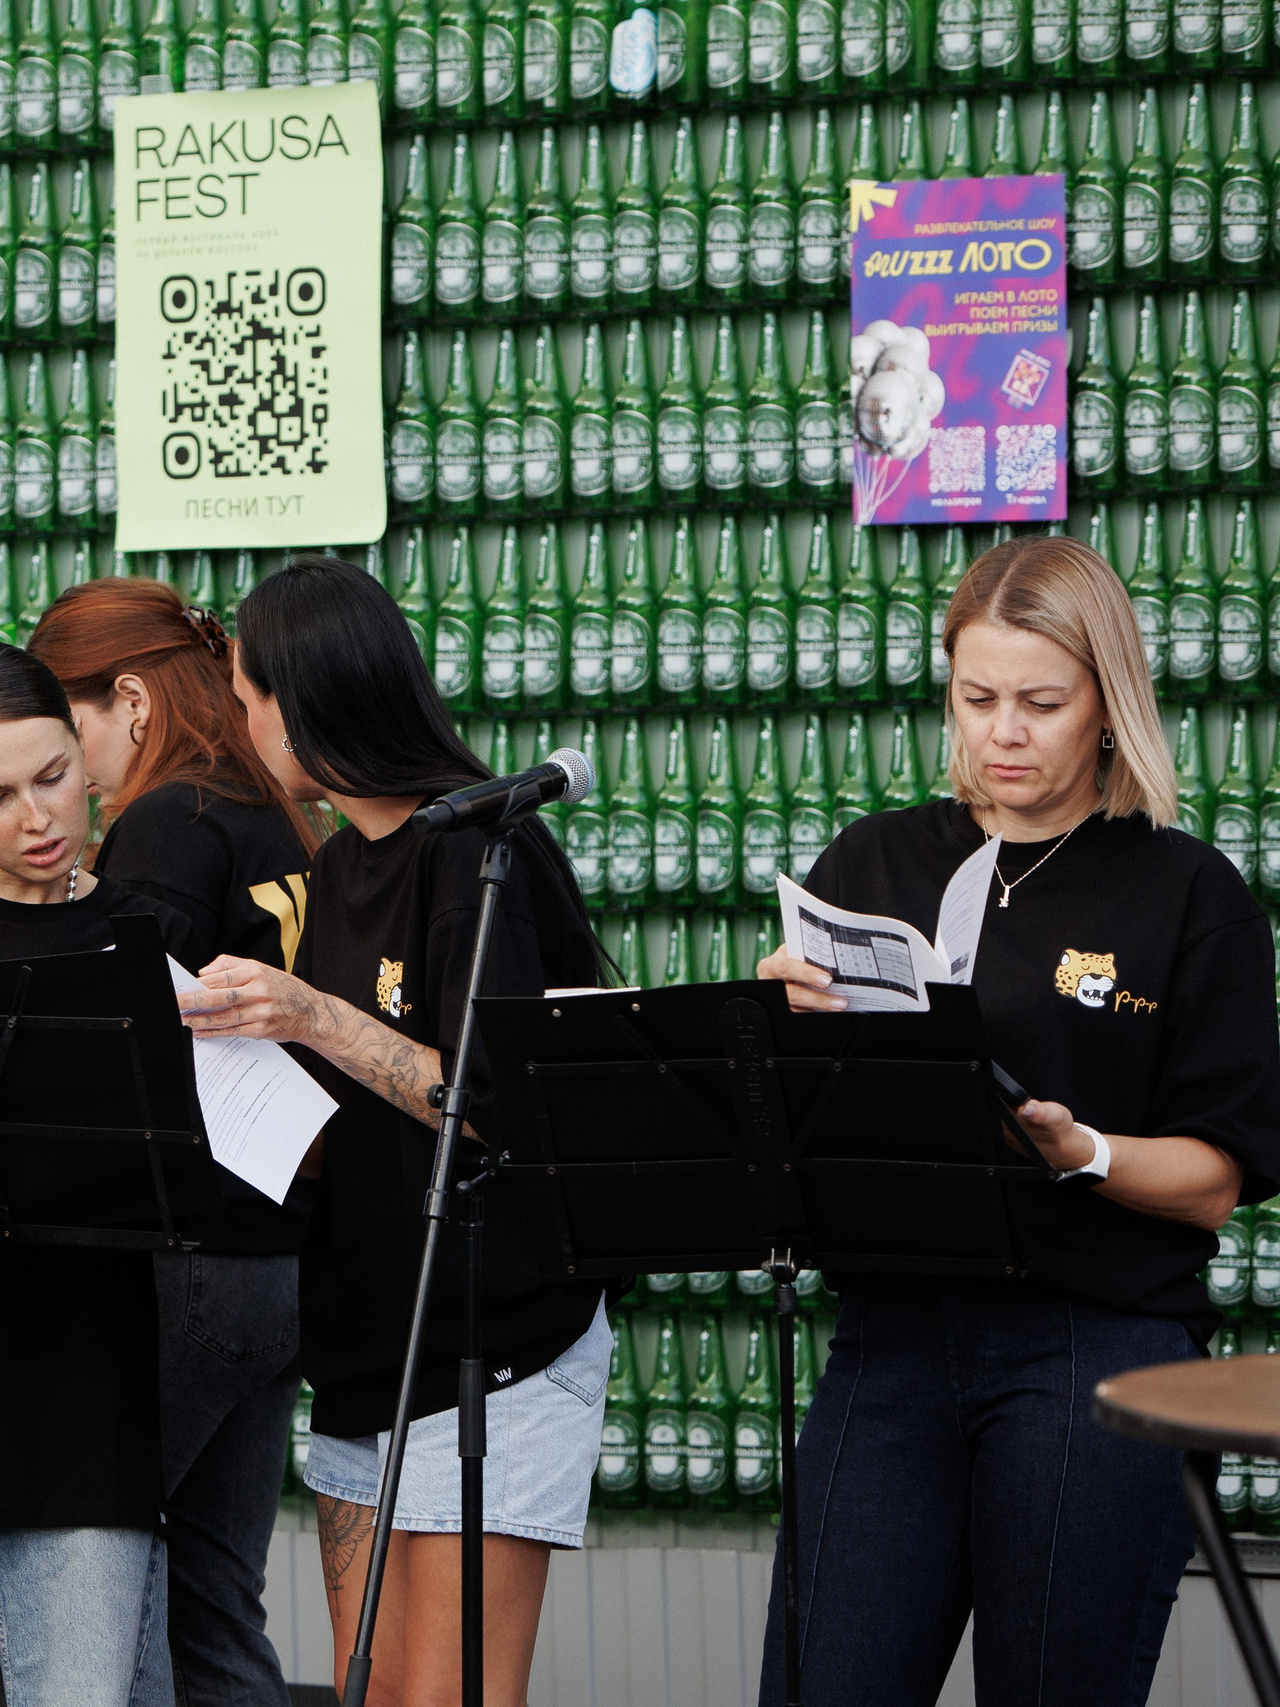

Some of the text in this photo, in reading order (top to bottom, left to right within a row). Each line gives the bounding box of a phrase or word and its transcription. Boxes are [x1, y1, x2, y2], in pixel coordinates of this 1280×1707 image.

[135, 113, 350, 170] RAKUSA
[135, 170, 261, 223] FEST
[914, 217, 1057, 236] РАЗВЛЕКАТЕЛЬНОЕ ШОУ
[958, 238, 1053, 273] ЛОТО
[954, 288, 1058, 306] ИГРАЕМ В ЛОТО
[969, 304, 1058, 320] ПОЕМ ПЕСНИ
[924, 318, 1058, 338] ВЫИГРЫВАЕМ ПРИЗЫ
[185, 493, 306, 520] ПЕСНИ ТУТ
